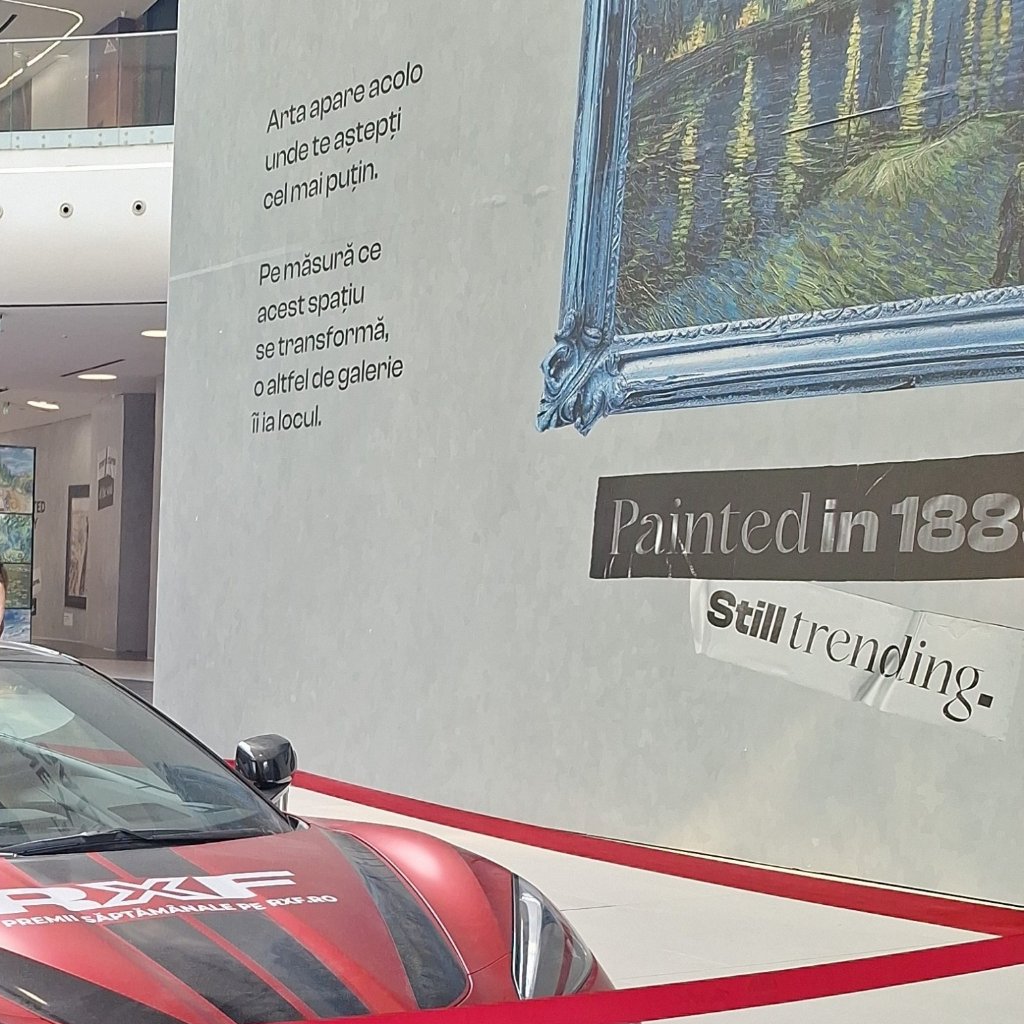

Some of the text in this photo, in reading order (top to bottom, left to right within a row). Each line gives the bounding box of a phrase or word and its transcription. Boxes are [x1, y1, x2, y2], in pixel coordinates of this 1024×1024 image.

[266, 61, 423, 133] Arta apare acolo
[265, 107, 402, 171] unde te aștepți
[263, 159, 378, 210] cel mai puțin.
[259, 241, 382, 286] Pe măsură ce
[257, 282, 365, 323] acest spațiu
[255, 315, 389, 360] se transformă,
[253, 355, 404, 397] o altfel de galerie
[262, 411, 275, 433] ia
[278, 404, 322, 432] locul.
[609, 491, 1024, 555] Painted in 188
[706, 589, 994, 722] Still trending.
[1, 894, 338, 928] PREMII SĂPTĂMÂNALE PE RXF.RO
